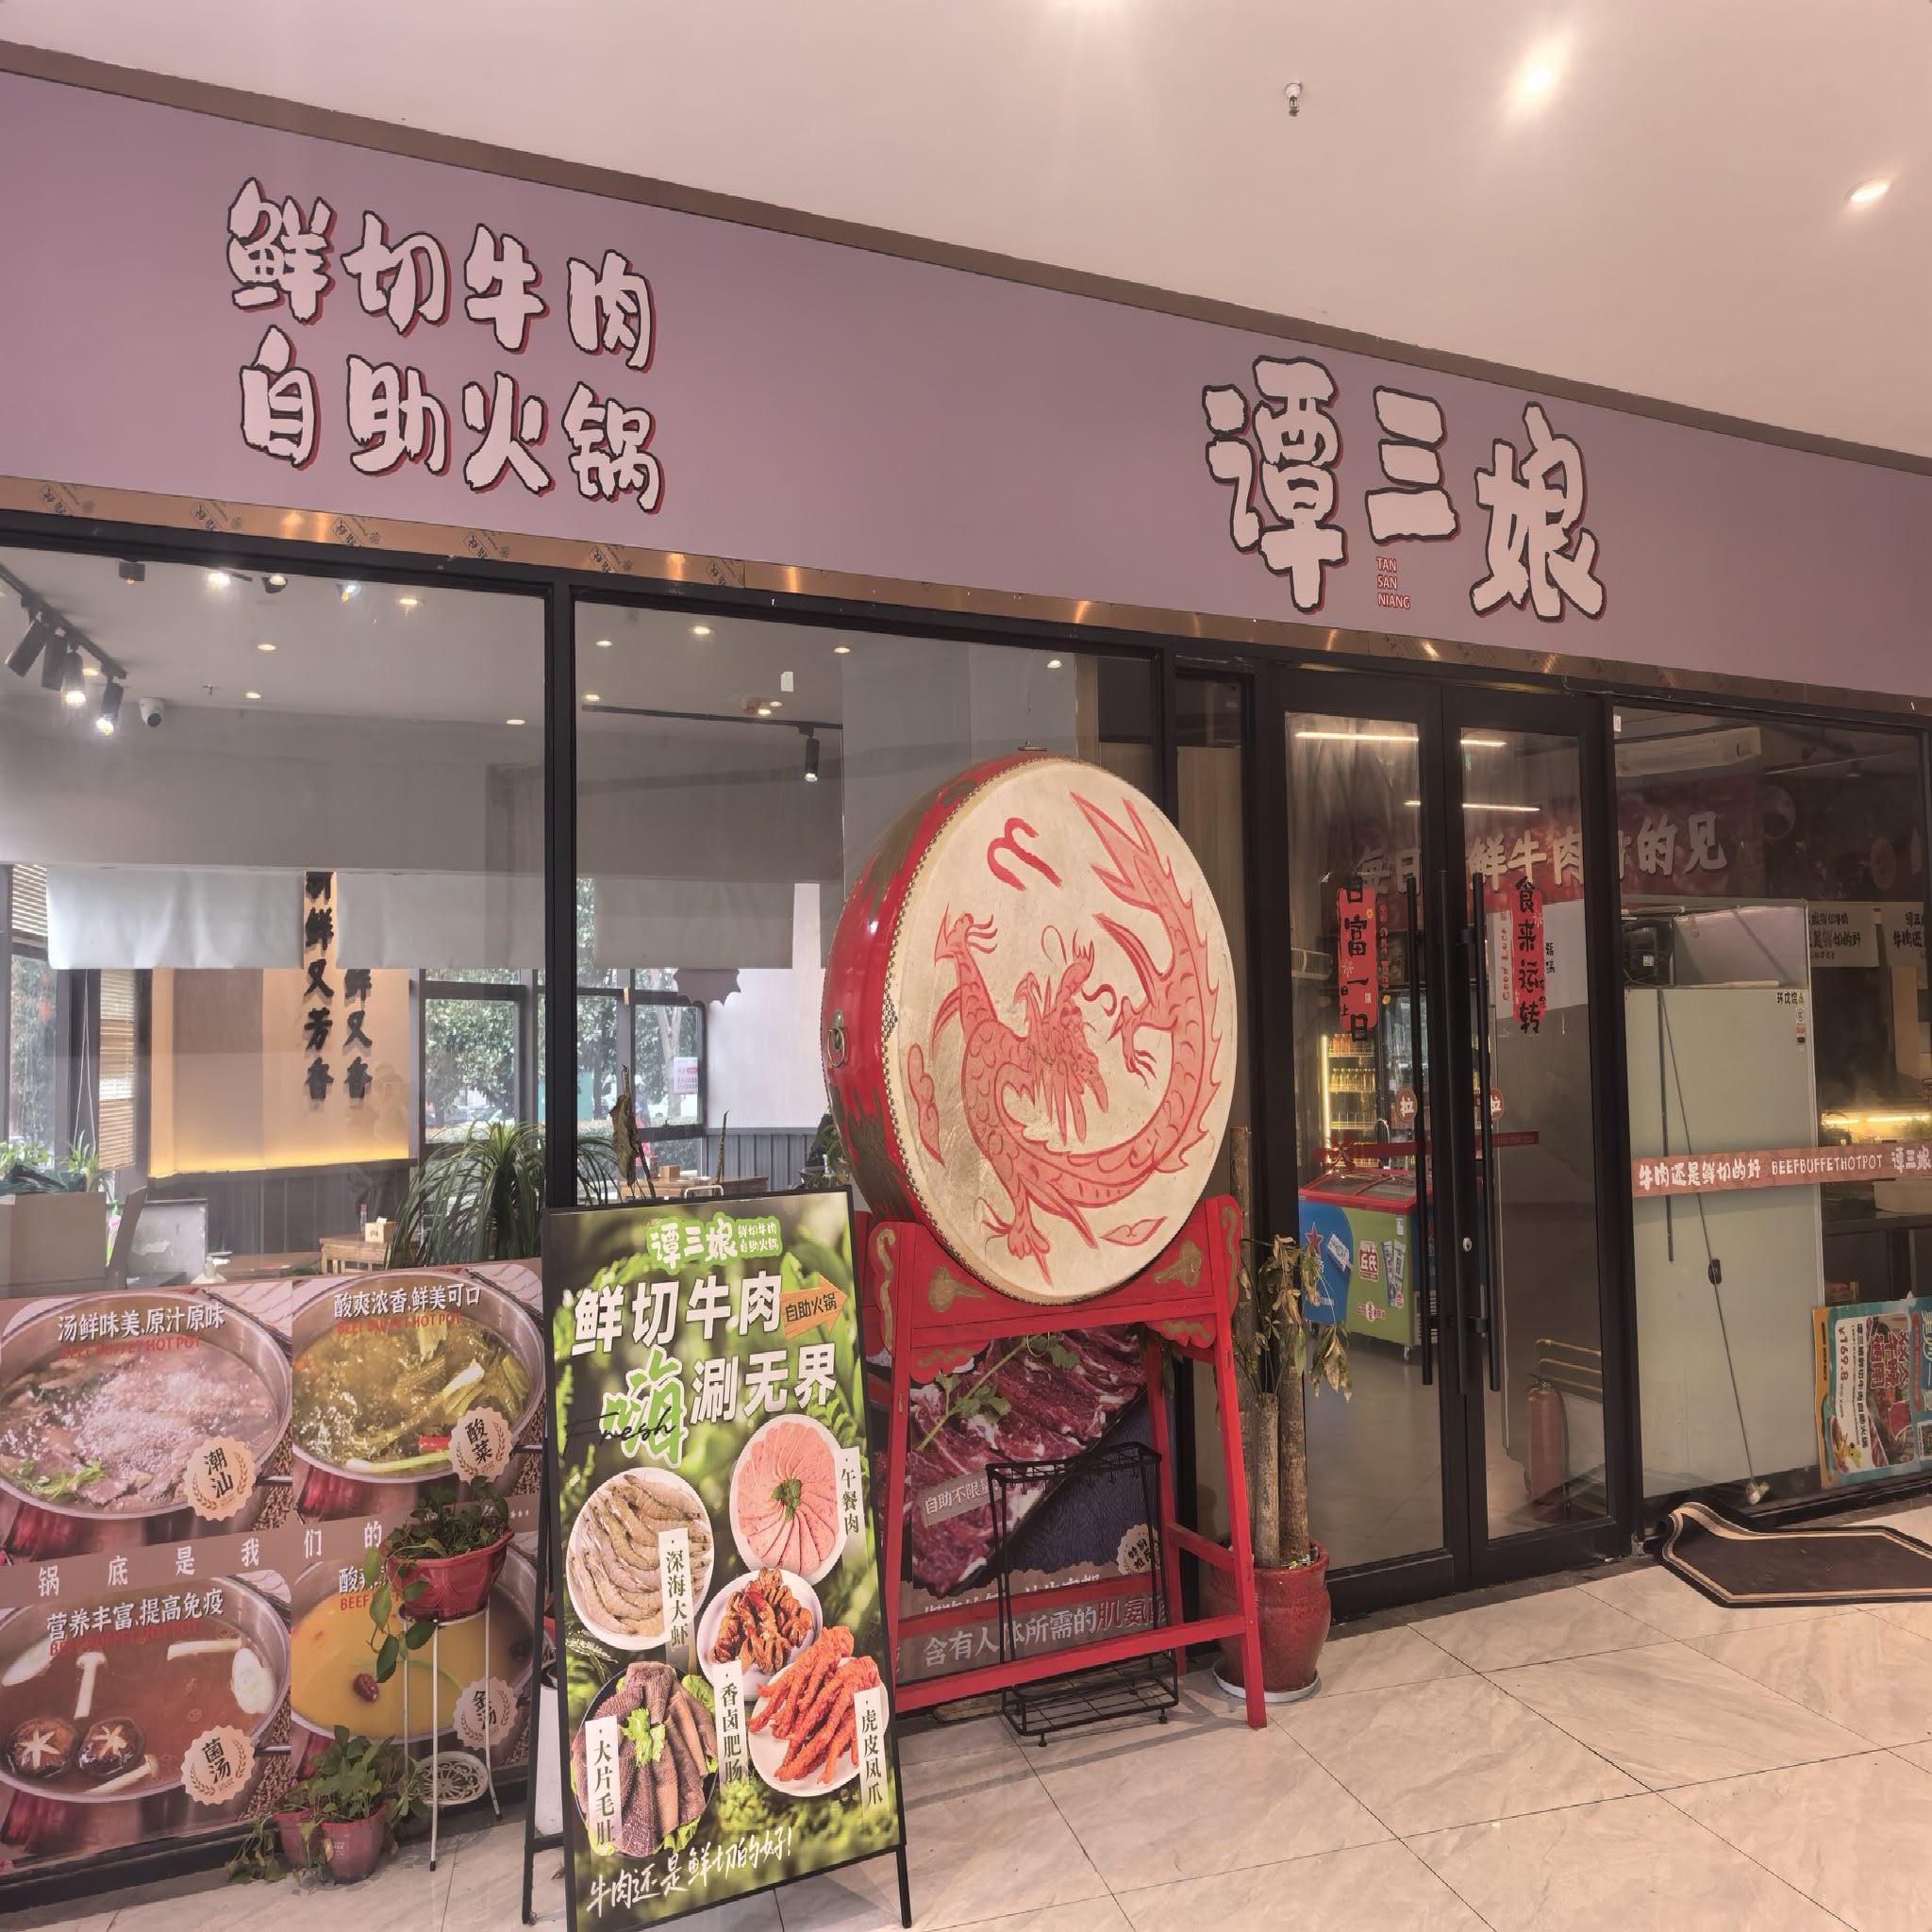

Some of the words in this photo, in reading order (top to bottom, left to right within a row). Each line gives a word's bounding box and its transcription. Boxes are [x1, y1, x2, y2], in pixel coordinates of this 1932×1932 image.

[227, 177, 654, 373] 鲜切牛肉
[240, 325, 665, 513] 自助火锅
[1202, 356, 1607, 622] 谭三娘
[1376, 557, 1397, 573] TAN
[1377, 575, 1398, 591] SAN
[1377, 593, 1411, 610] NIANG
[1400, 1095, 1414, 1118] 拉
[1639, 1158, 1761, 1191] 牛肉还是鲜切的好
[650, 1218, 738, 1269] 谭三娘
[572, 1271, 782, 1356] 鲜切牛肉
[785, 1293, 837, 1323] 自助火锅
[465, 1418, 493, 1465] 酸菜
[204, 1448, 234, 1498] 潮汕
[841, 1468, 859, 1536] 午餐肉
[340, 1594, 369, 1610] BEEF
[665, 1549, 689, 1647] 深海大虾
[720, 1684, 744, 1783] 香卤肥肠
[861, 1707, 884, 1807] 虎皮凤爪
[202, 1737, 231, 1784] 菌汤
[592, 1740, 616, 1845] 大片毛肚
